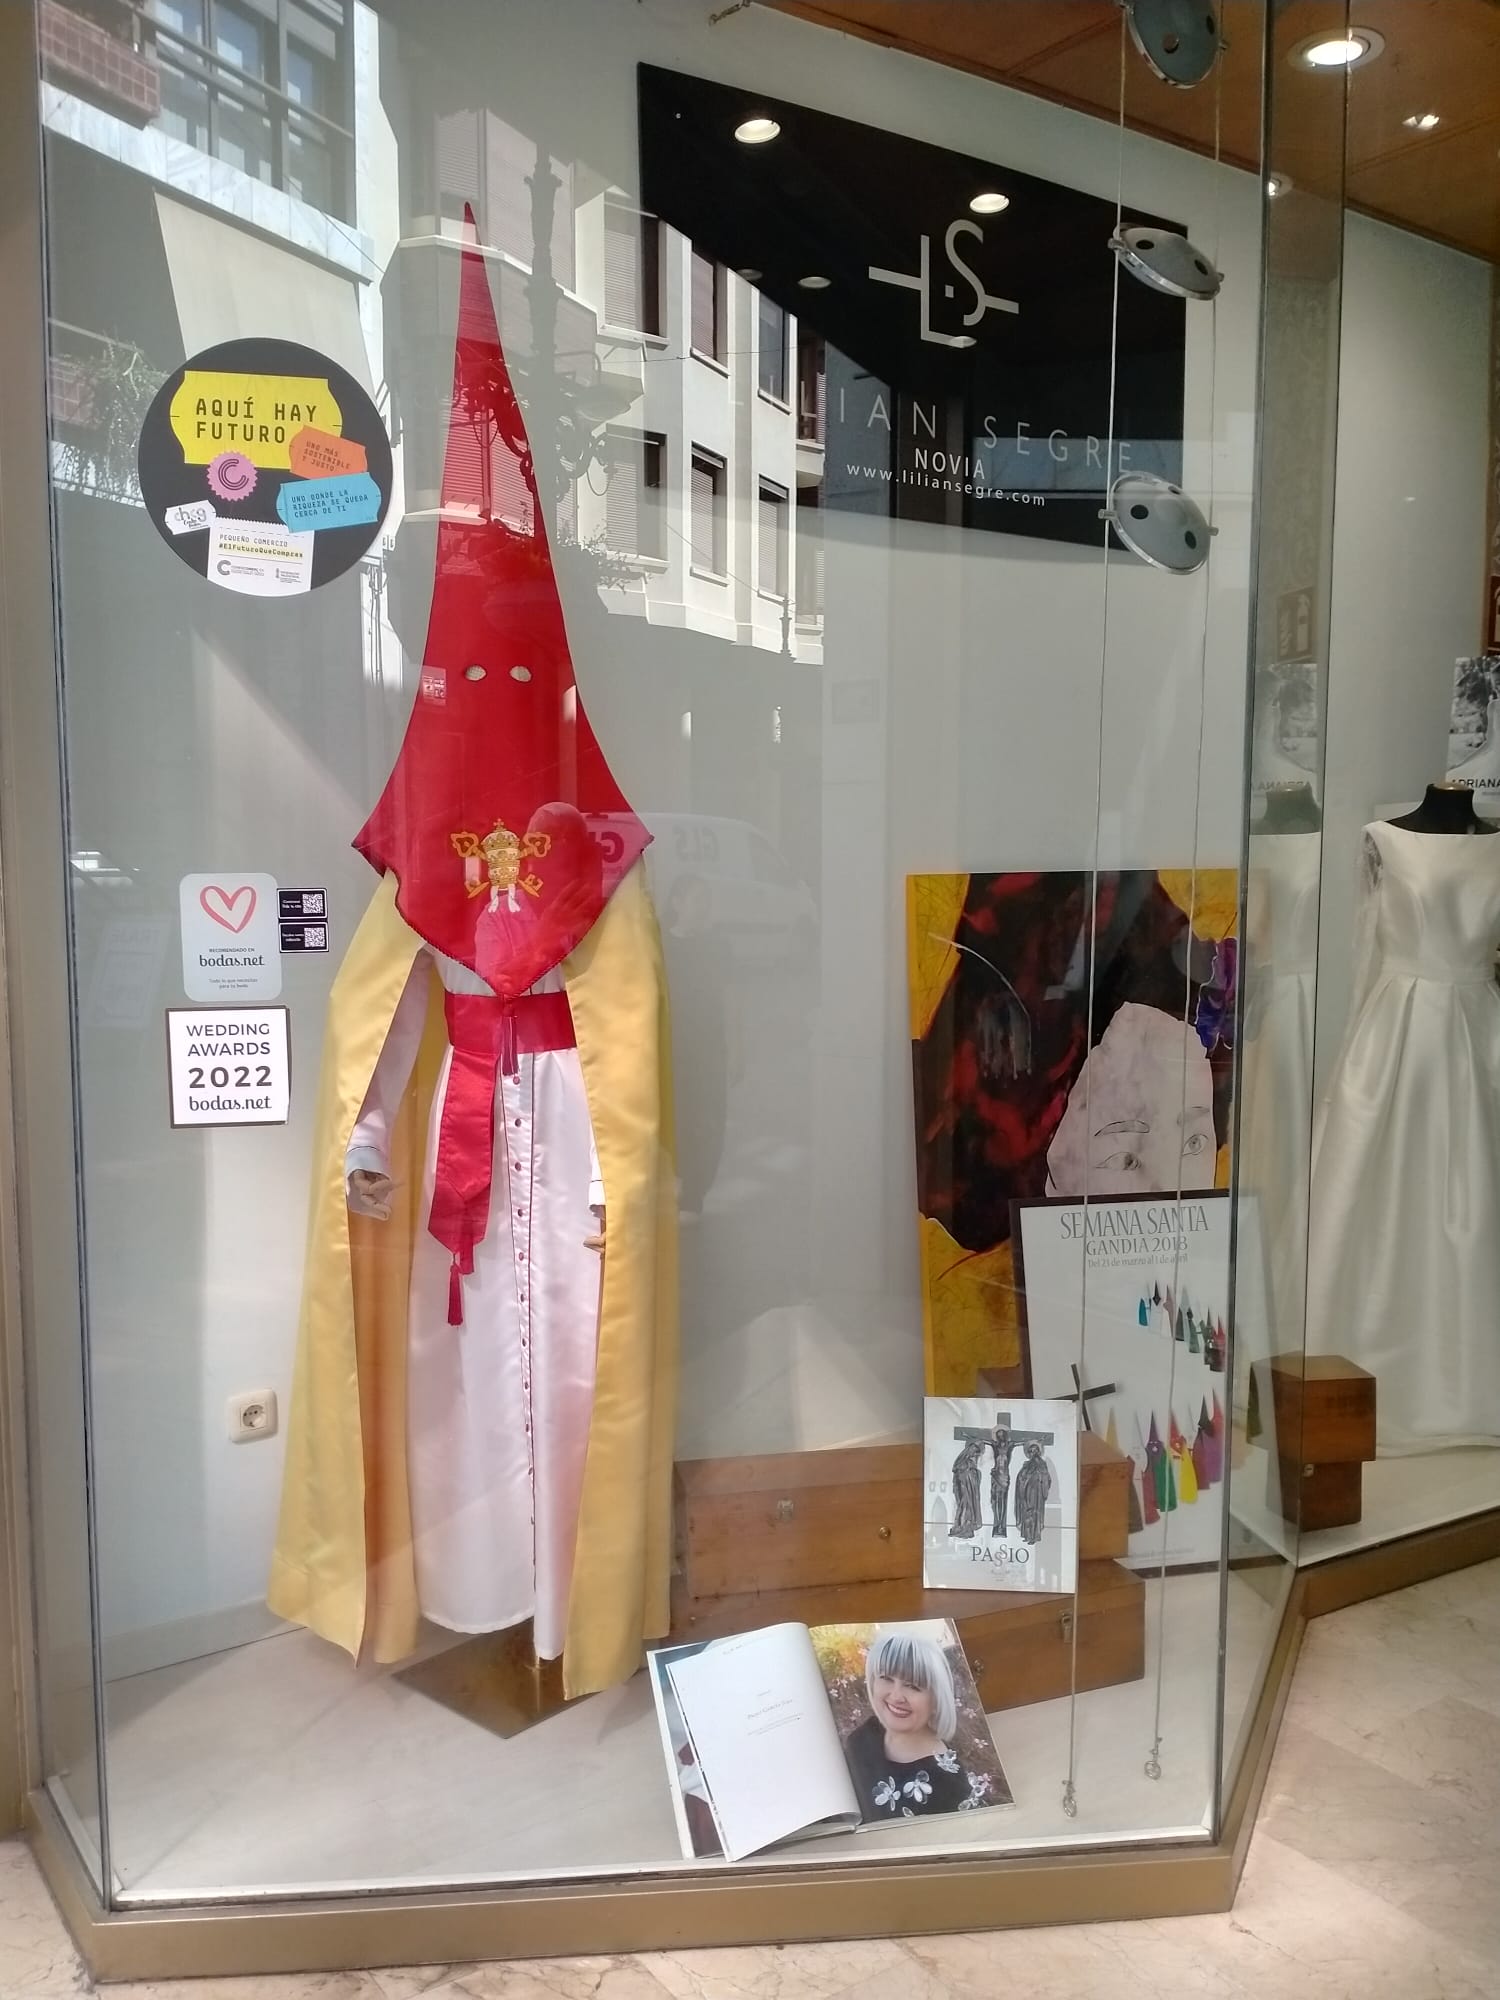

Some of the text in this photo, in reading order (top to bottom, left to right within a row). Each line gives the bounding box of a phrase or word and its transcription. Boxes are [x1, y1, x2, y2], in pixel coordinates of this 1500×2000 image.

[195, 397, 317, 422] AQUÍ HAY
[196, 422, 286, 443] FUTURO
[306, 441, 320, 450] UNO
[983, 415, 1132, 473] SEGRE
[304, 448, 351, 469] SOSTENIBLE
[311, 459, 335, 471] JUSTO
[915, 447, 985, 479] NOVIA
[847, 463, 1046, 506] www.liliansegre.com
[291, 495, 306, 503] UNO
[293, 501, 326, 511] RIQUEZA
[345, 494, 369, 504] QUEDA
[294, 509, 318, 518] CERCA
[219, 534, 288, 547] PEQUEÑO COMERCIO
[199, 954, 265, 967] bodas.net
[186, 1023, 270, 1037] WEDDING
[187, 1042, 271, 1057] AWARDS
[188, 1065, 272, 1088] 2022
[189, 1095, 272, 1112] bodas.net
[1060, 1205, 1209, 1239] SEMANA SANTA
[1086, 1237, 1150, 1256] GANDIA
